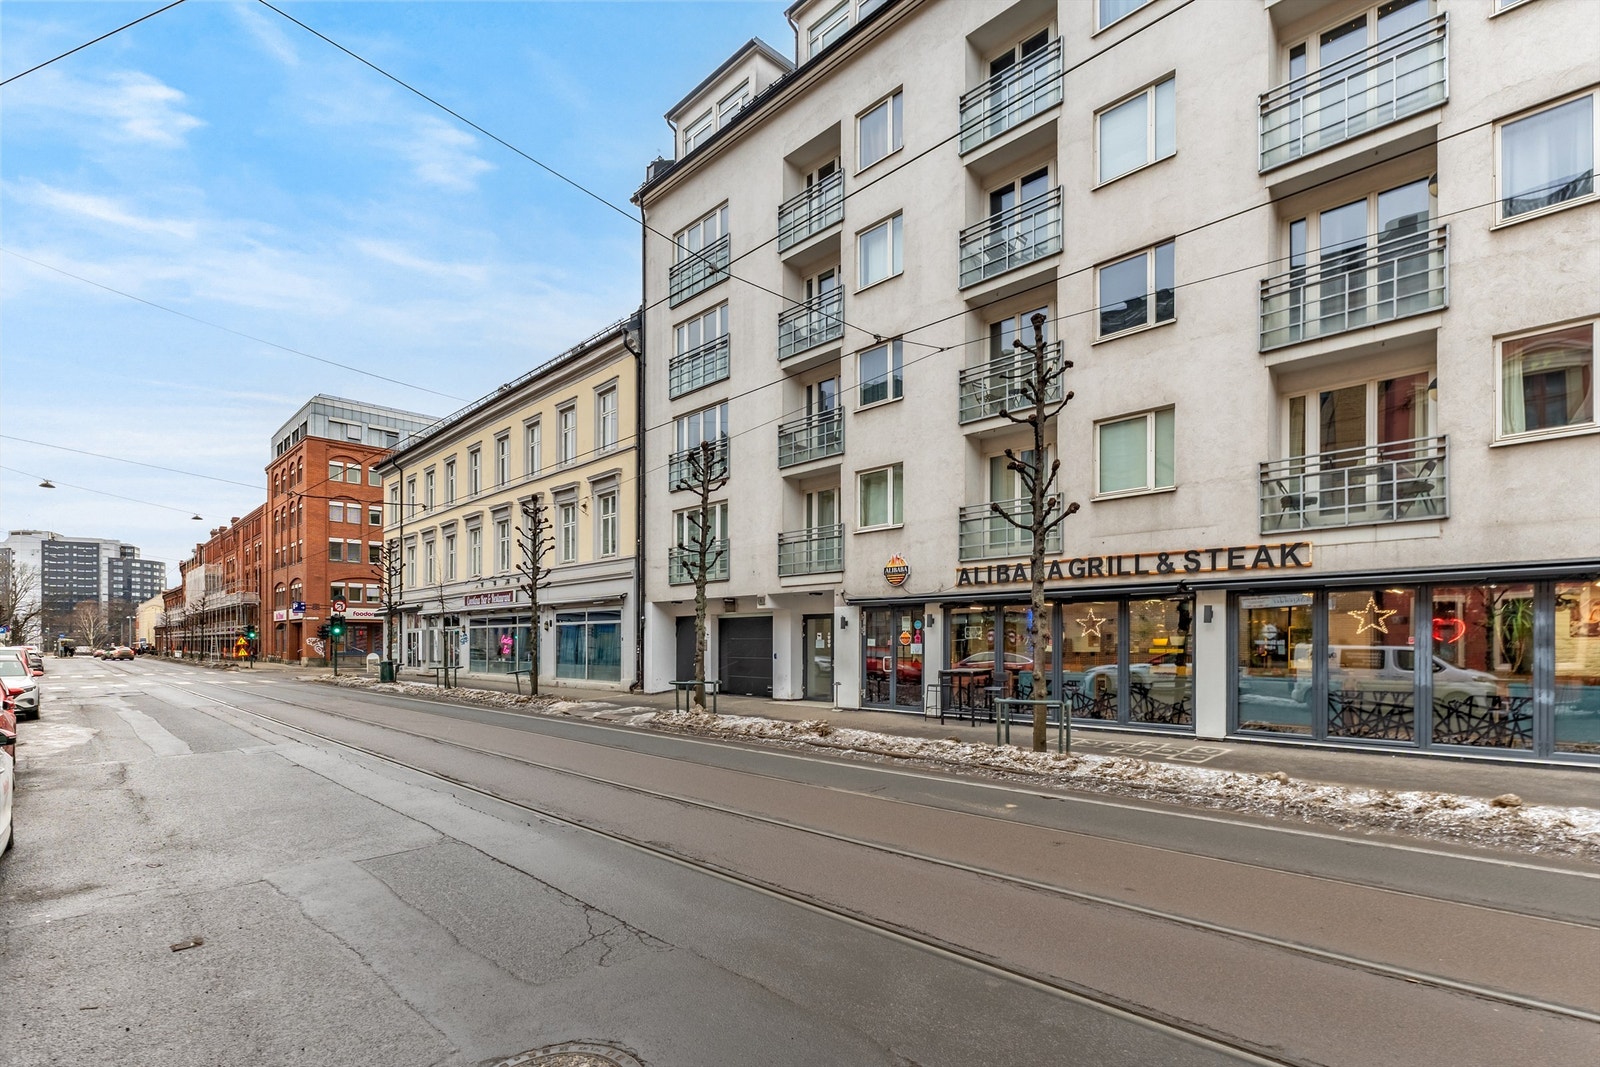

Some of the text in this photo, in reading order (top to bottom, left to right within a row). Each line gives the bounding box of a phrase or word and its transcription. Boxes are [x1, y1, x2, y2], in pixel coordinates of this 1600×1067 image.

[885, 566, 908, 574] ALIBABA
[957, 542, 1304, 586] ALIBAA GRILL & STEAK
